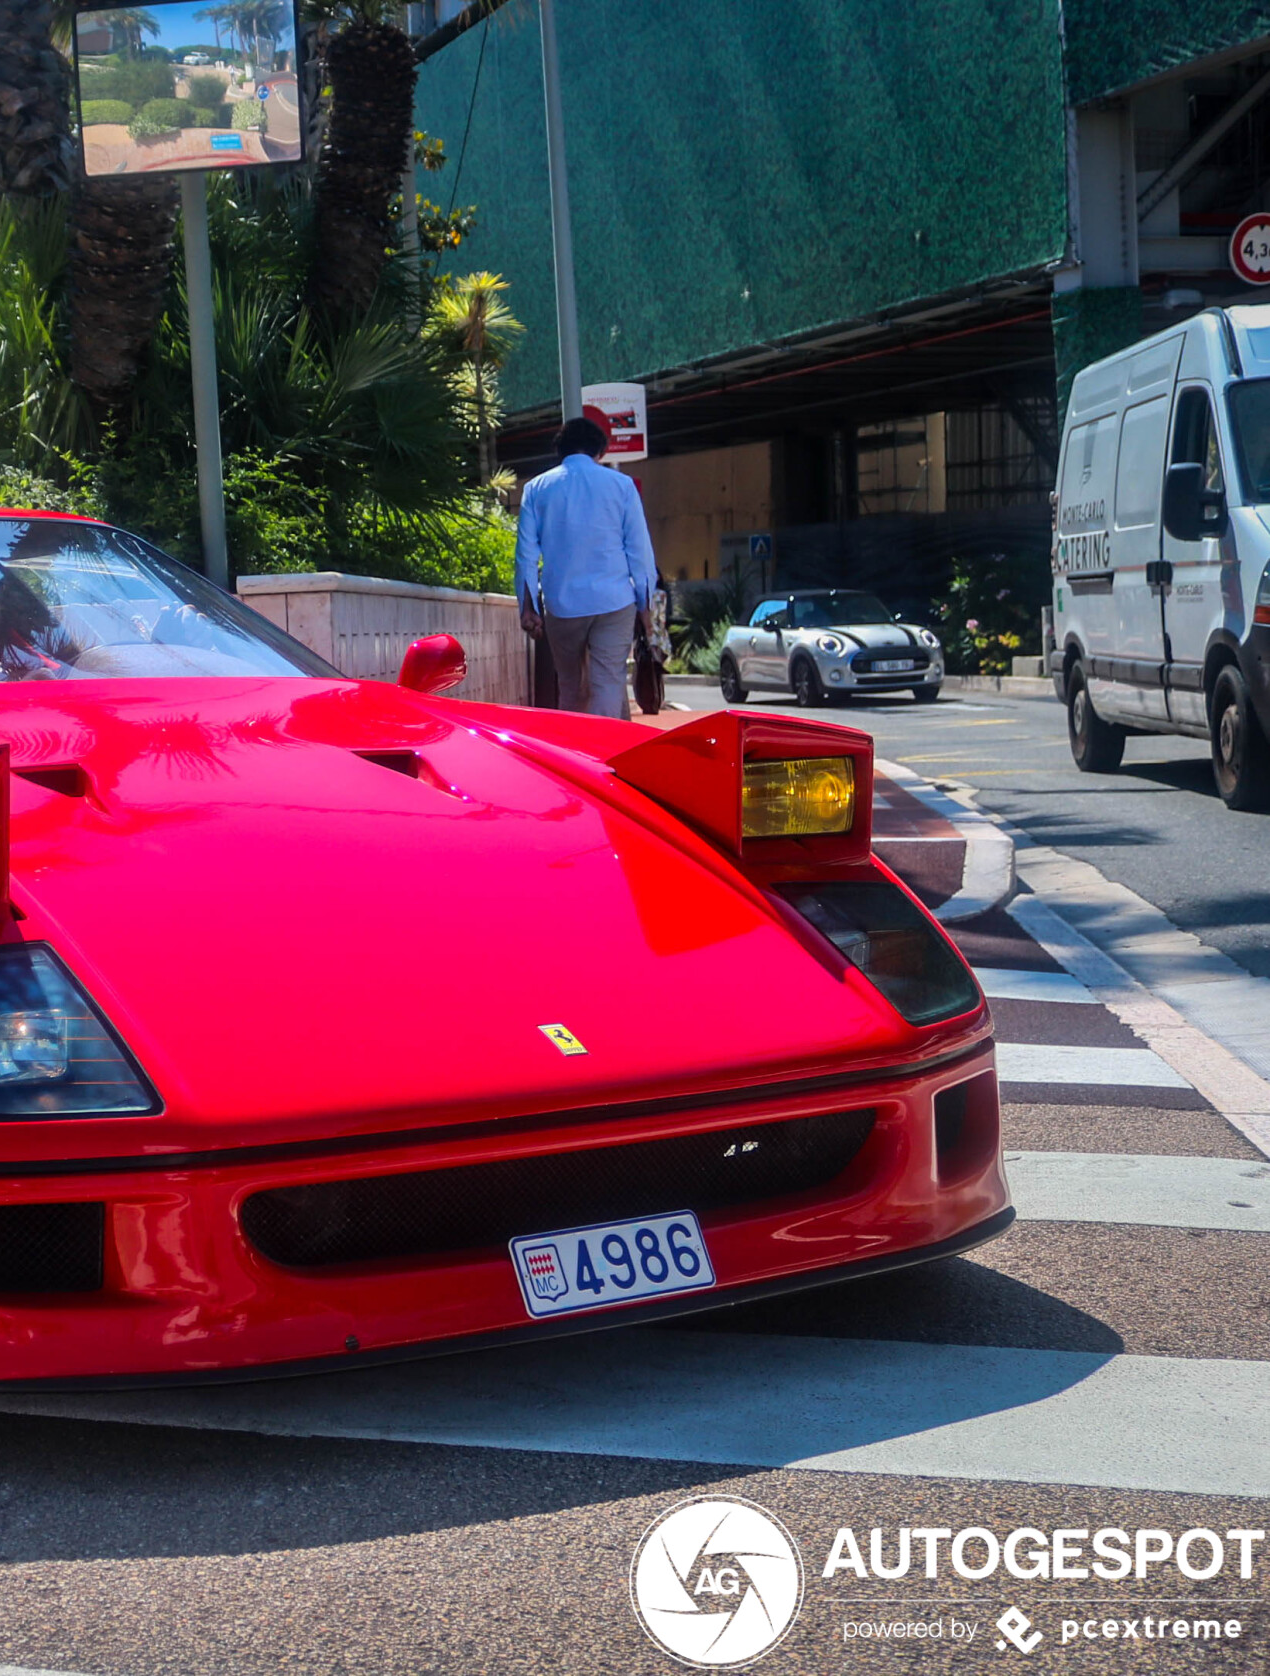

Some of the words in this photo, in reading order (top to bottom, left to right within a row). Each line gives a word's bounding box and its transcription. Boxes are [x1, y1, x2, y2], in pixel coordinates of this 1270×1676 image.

[1243, 240, 1270, 260] 4,3
[1063, 499, 1105, 525] MONTE-CARLO
[1057, 531, 1110, 571] CATERING
[576, 1222, 701, 1295] 4986
[536, 1275, 559, 1293] MC
